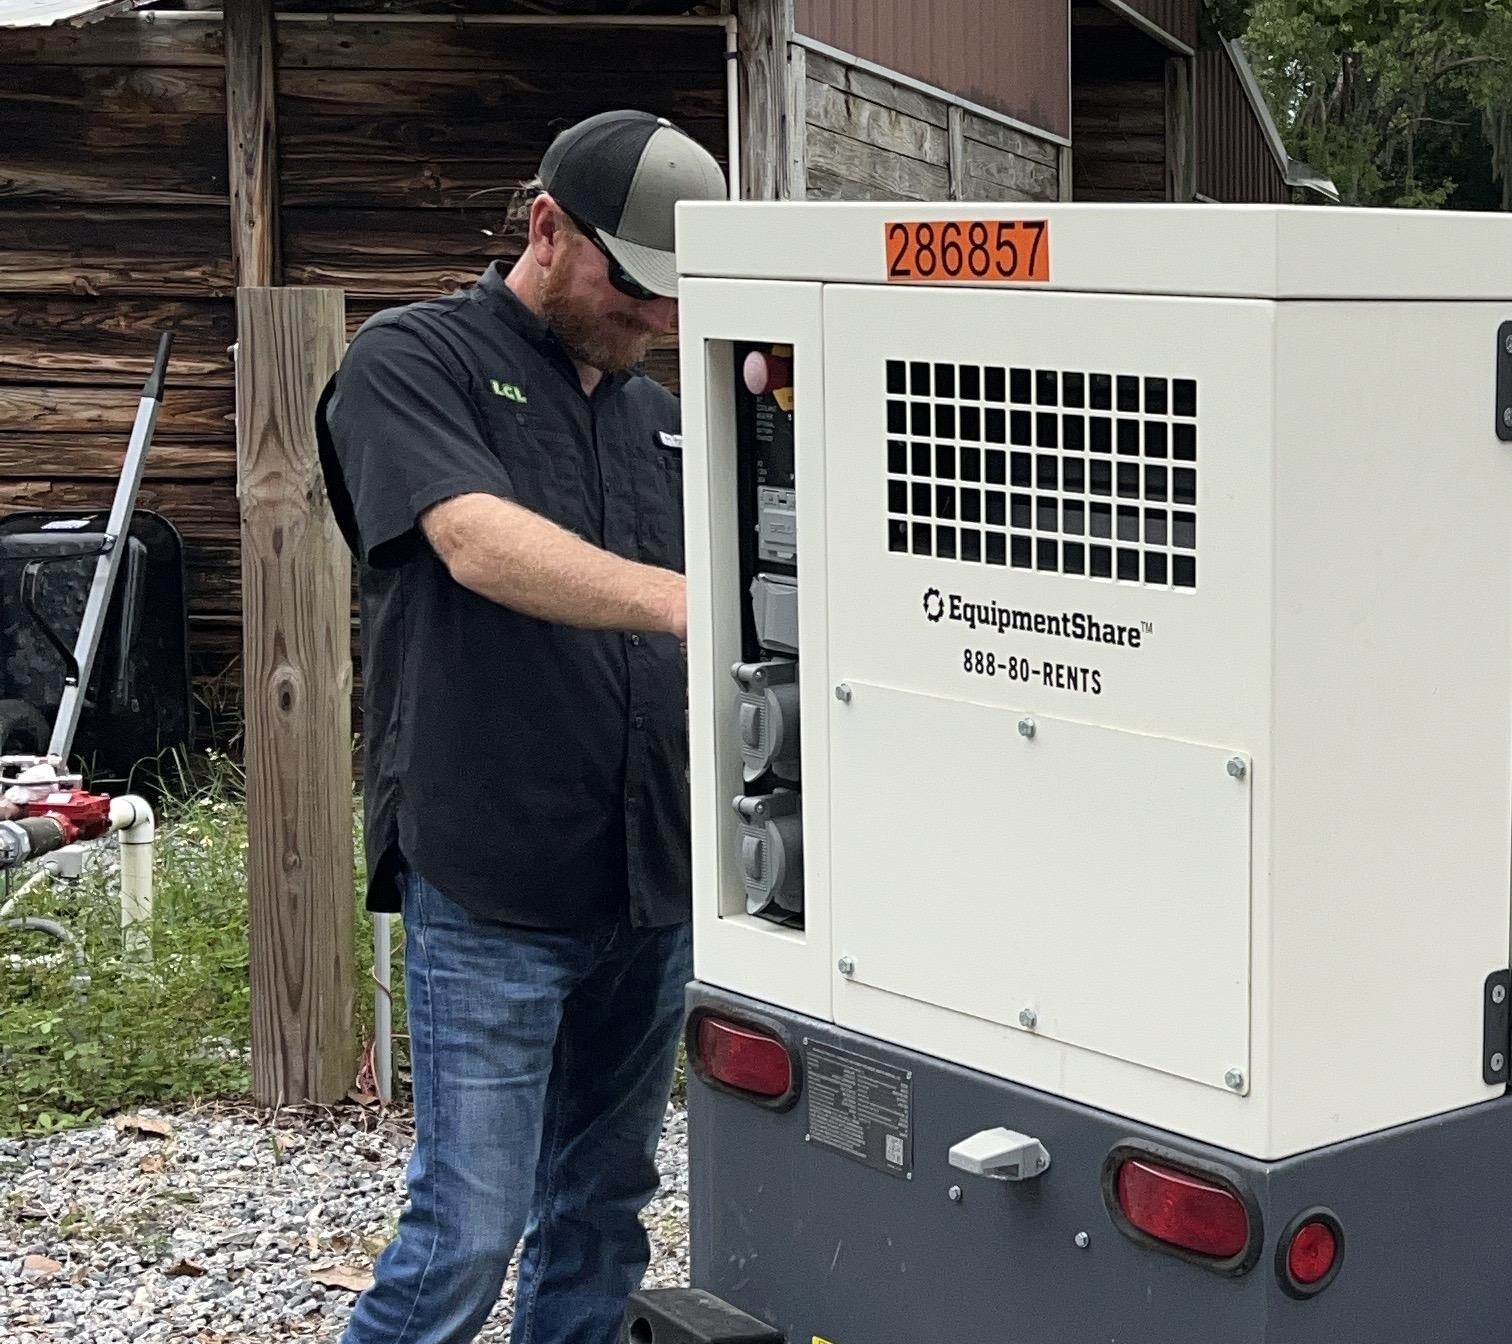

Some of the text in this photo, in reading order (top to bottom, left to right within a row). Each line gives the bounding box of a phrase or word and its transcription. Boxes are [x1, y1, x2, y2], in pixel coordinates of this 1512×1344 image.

[889, 222, 1045, 276] 286857
[948, 594, 1141, 649] EquipmentShare
[963, 648, 1102, 695] 888-80-RENTS
